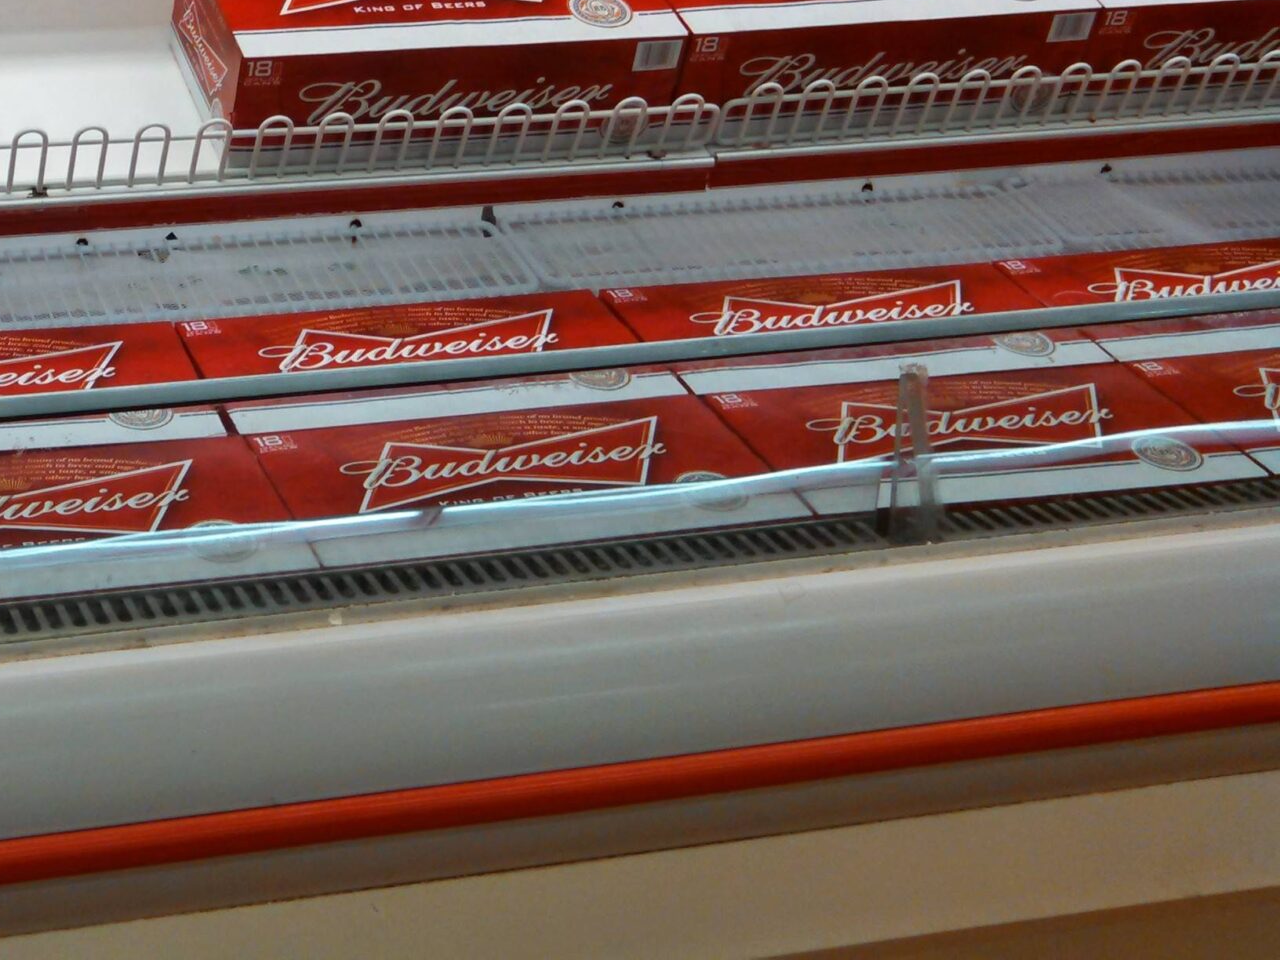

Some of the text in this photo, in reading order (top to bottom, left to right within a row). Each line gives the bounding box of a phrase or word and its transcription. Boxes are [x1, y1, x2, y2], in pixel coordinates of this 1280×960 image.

[353, 0, 486, 14] KING OF BEERS
[1105, 10, 1128, 26] 18
[695, 36, 719, 52] 18
[246, 60, 272, 77] 18
[740, 47, 1027, 99] Budweiser
[299, 76, 613, 124] Budweiser
[1000, 260, 1026, 269] 18
[607, 289, 633, 298] 18
[689, 298, 974, 338] Budweiser
[182, 322, 209, 331] 18
[258, 331, 559, 373] Budweiser
[714, 393, 743, 404] 18
[253, 435, 283, 447] 18
[340, 440, 667, 490] Budweiser
